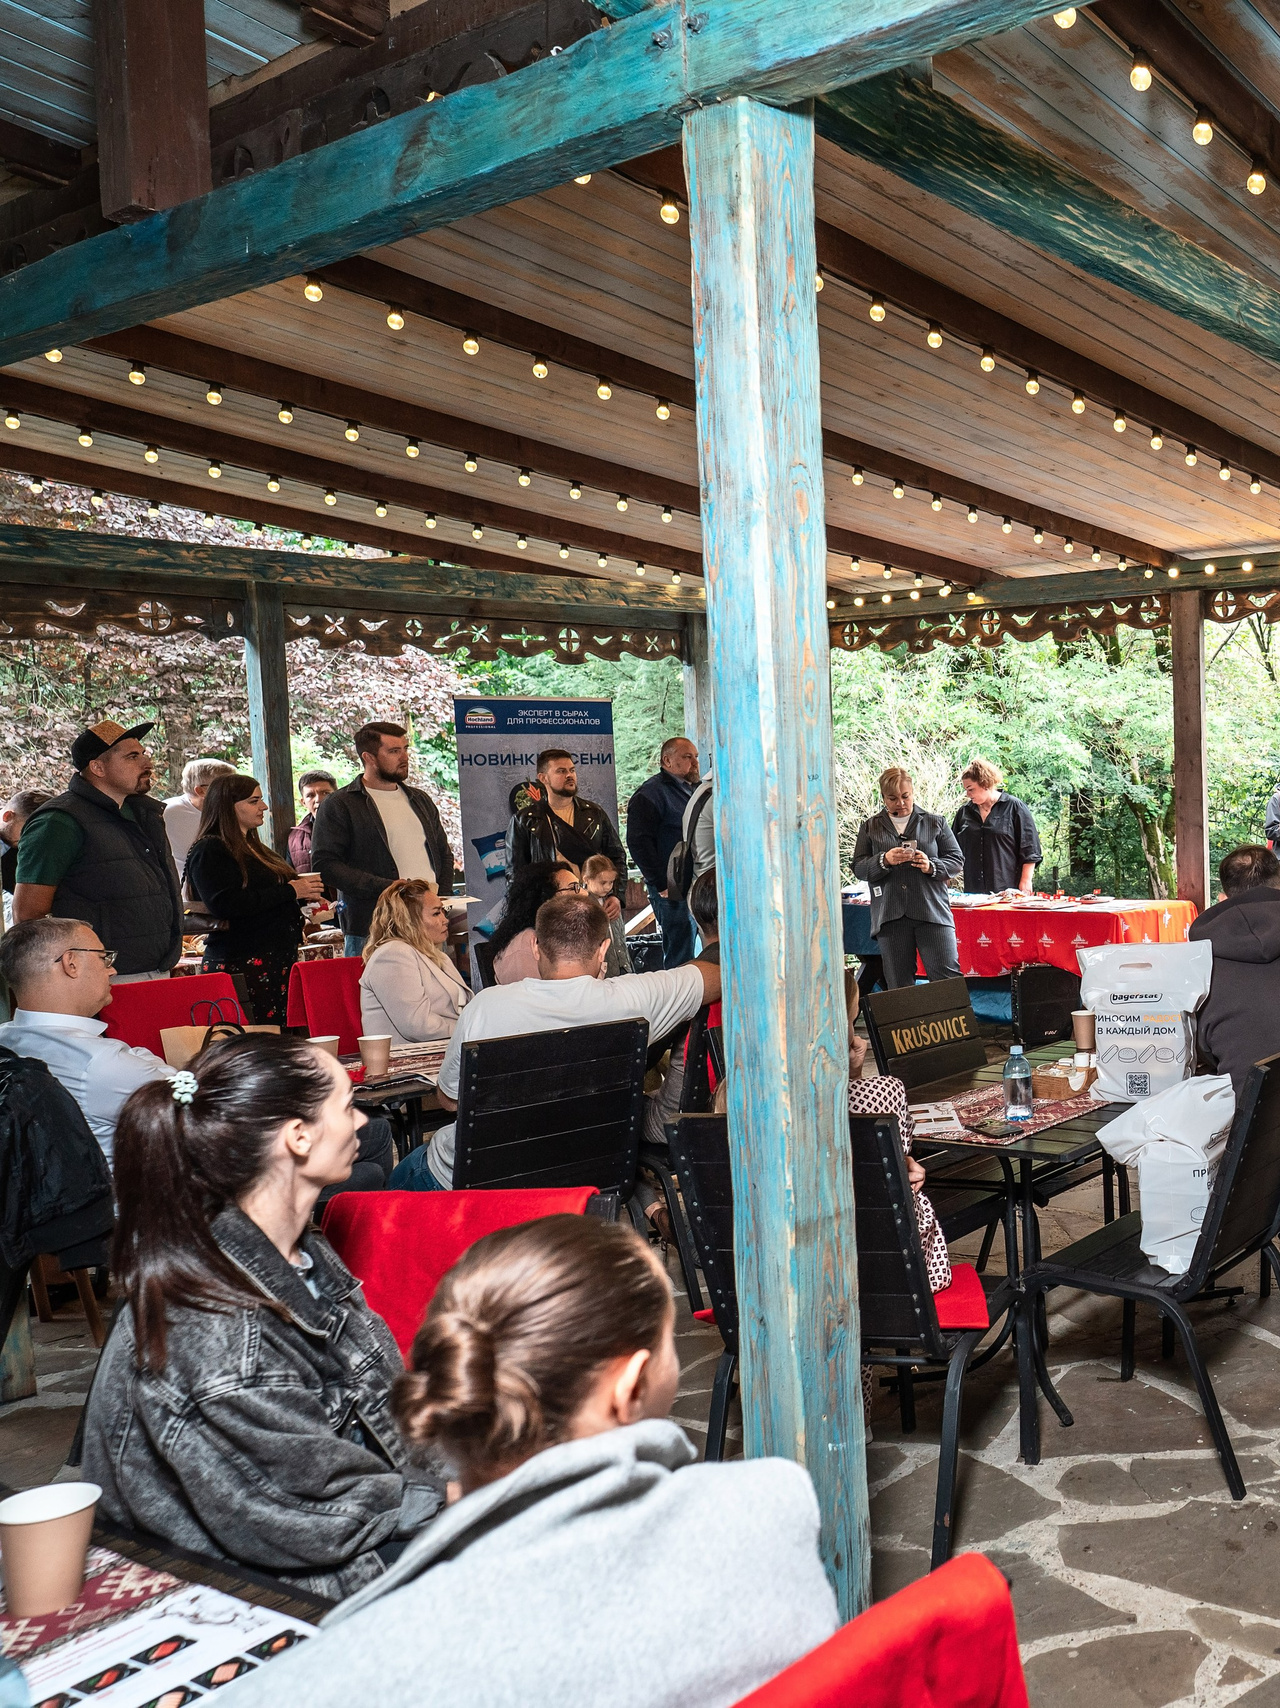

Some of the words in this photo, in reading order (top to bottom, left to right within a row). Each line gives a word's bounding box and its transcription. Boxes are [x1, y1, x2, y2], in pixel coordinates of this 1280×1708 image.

[507, 717, 525, 725] ДЛЯ
[526, 717, 601, 725] ПРОФЕССИОНАЛОВ
[1112, 993, 1158, 1002] bagerstat
[891, 1015, 970, 1055] KRUŠOVICE
[1097, 1027, 1104, 1035] В
[1106, 1026, 1151, 1035] КАЖДЫЙ
[1153, 1027, 1176, 1036] ДОМ
